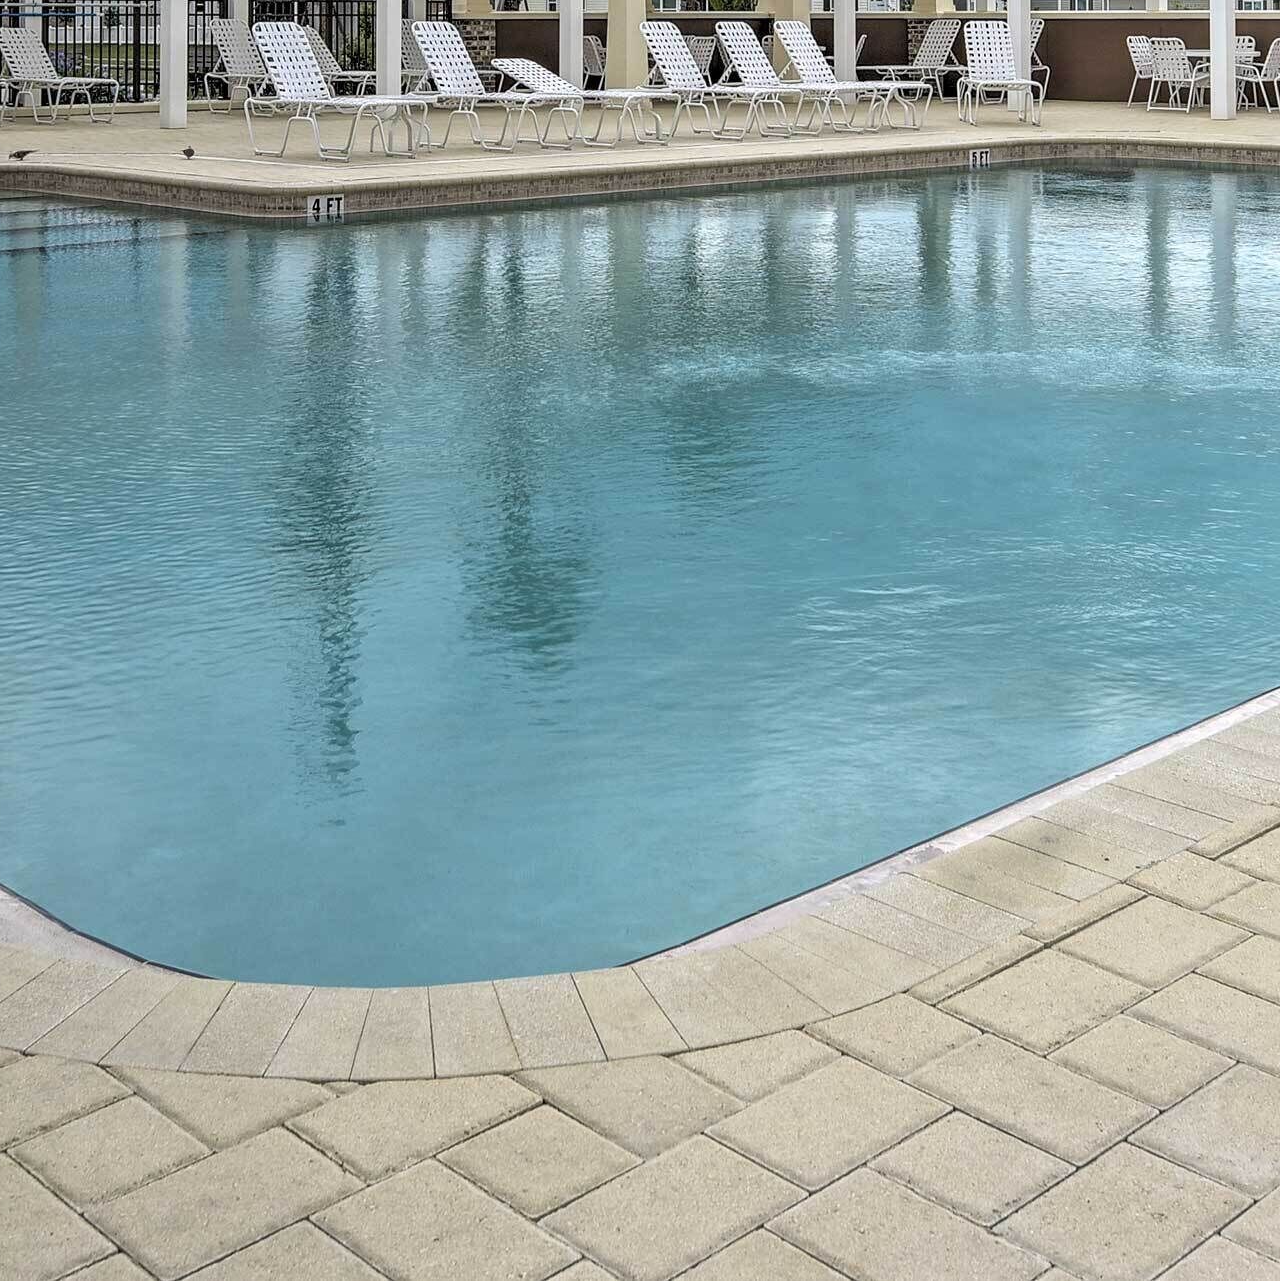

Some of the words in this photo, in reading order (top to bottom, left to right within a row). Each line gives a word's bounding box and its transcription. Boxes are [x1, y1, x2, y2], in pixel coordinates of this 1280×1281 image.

[972, 152, 978, 165] 5
[980, 151, 989, 164] FT
[312, 198, 321, 214] 4
[326, 197, 343, 215] FT
